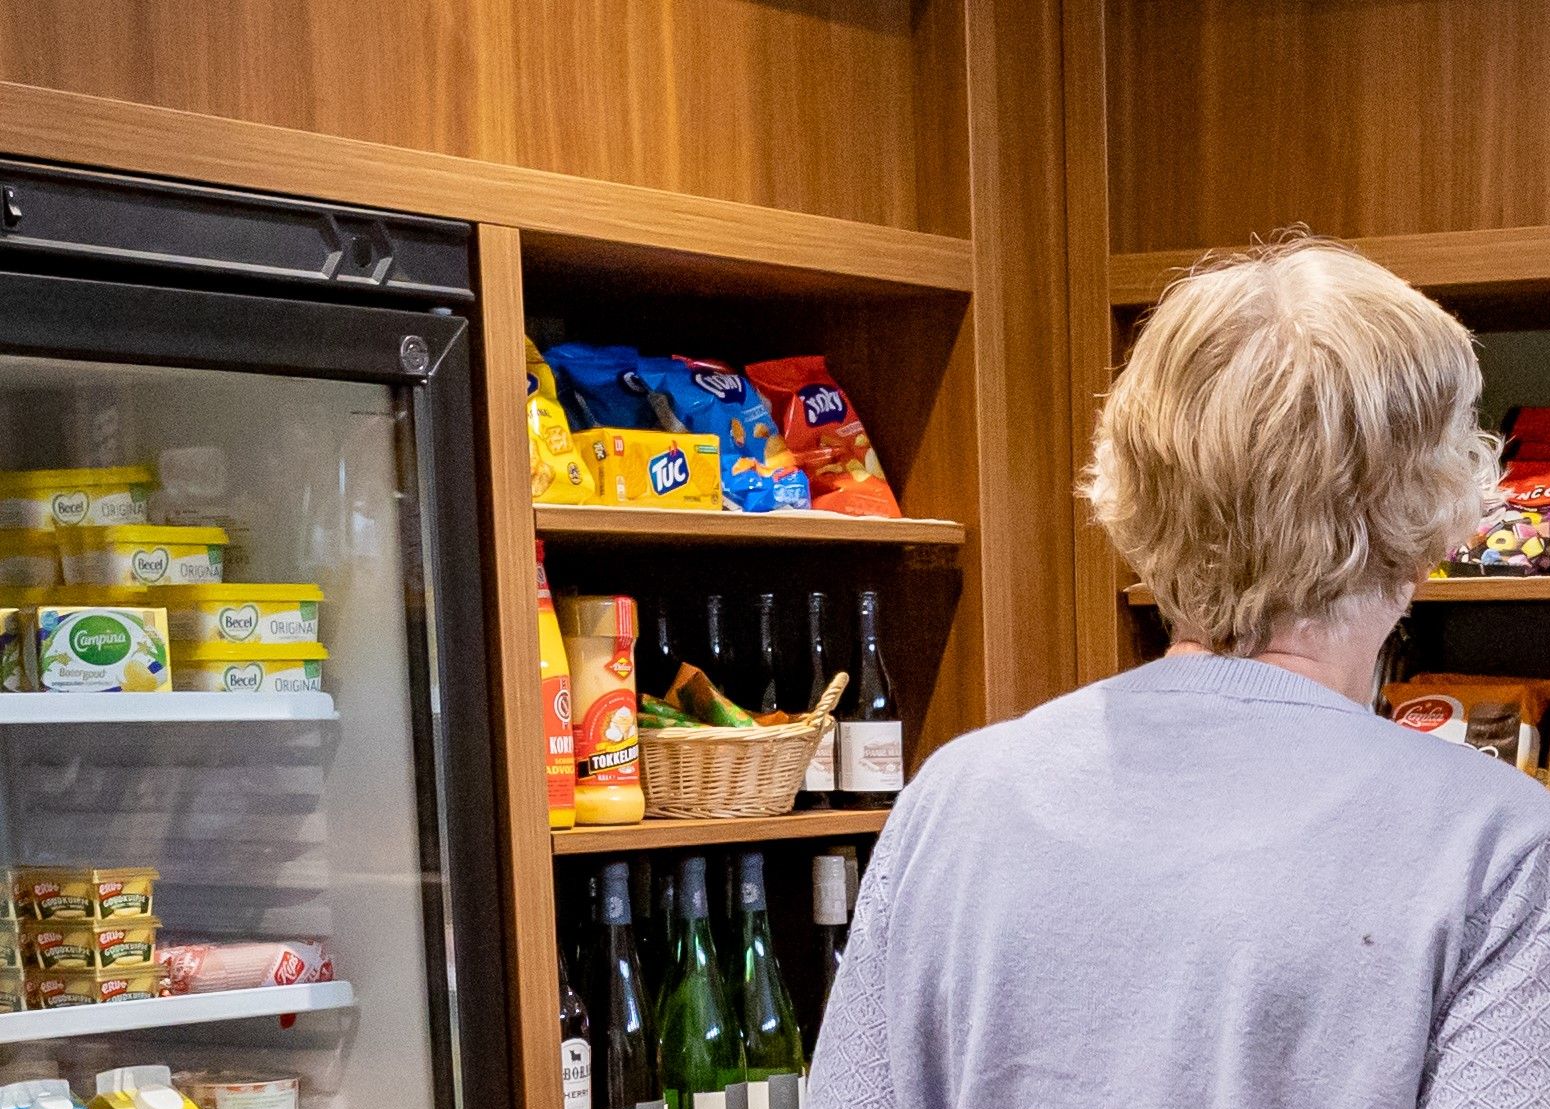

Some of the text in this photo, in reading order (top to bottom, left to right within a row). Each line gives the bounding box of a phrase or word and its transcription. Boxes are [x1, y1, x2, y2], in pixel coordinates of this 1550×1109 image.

[651, 457, 686, 492] TUC
[58, 502, 84, 514] Becel
[101, 504, 144, 517] ORIGINA
[138, 558, 163, 571] Becel
[180, 563, 220, 578] ORIGINA
[225, 615, 253, 629] Becel
[74, 630, 126, 652] Campina
[230, 674, 257, 688] Becel
